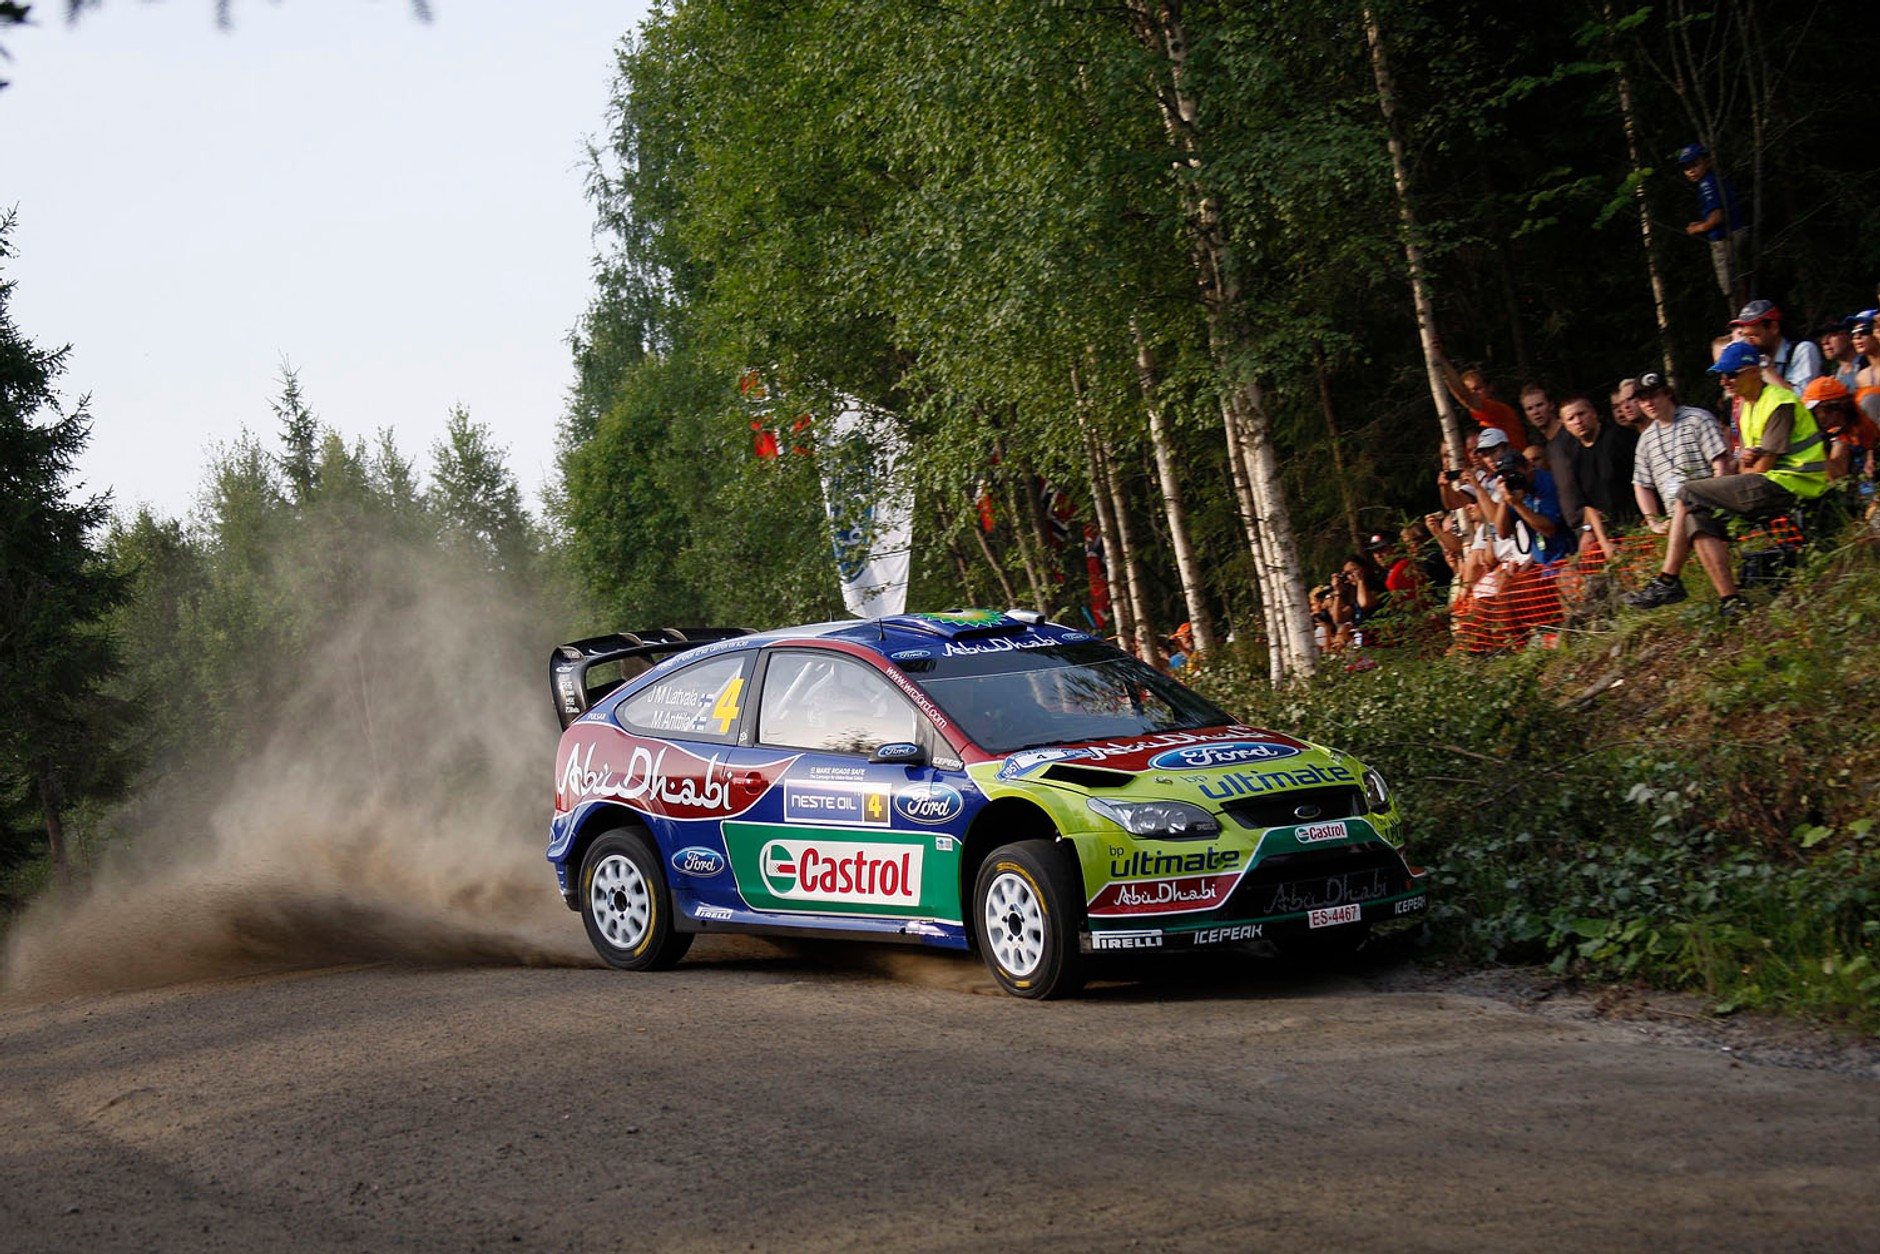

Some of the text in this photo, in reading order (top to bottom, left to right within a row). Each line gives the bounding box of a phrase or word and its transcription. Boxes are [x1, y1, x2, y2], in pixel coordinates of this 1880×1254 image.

[665, 687, 698, 707] Latvala
[712, 678, 745, 733] 4
[1179, 745, 1278, 766] Ford
[557, 742, 734, 811] Abu Dhabi
[1198, 763, 1355, 800] ultimate
[836, 796, 857, 811] OIL
[868, 792, 882, 818] 4
[907, 790, 951, 817] Ford
[1309, 824, 1346, 840] Castrol
[1109, 845, 1125, 858] bp
[1111, 847, 1240, 878] ultimate
[799, 847, 913, 897] Castrol
[1113, 879, 1217, 906] Abu Dhabi
[1311, 905, 1358, 926] ES-4467
[1091, 929, 1163, 949] PIRELLI
[1193, 923, 1263, 945] ICEPEAK
